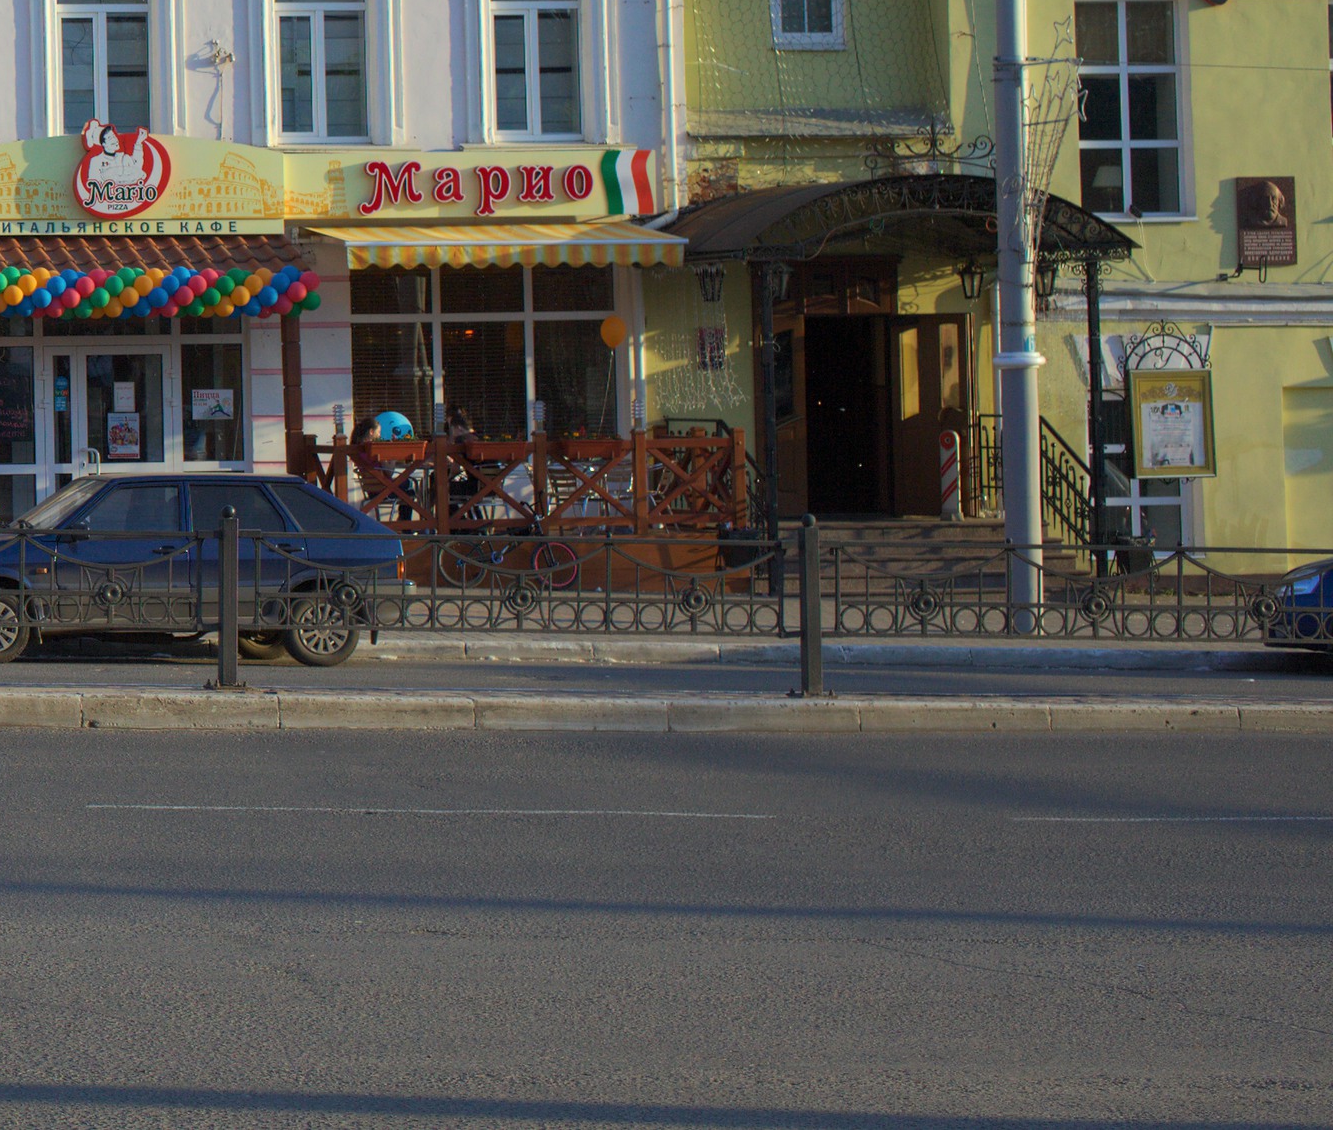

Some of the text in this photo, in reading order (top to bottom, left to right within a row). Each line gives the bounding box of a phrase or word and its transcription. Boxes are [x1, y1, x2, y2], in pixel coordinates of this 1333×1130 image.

[84, 181, 158, 206] Mario
[359, 161, 594, 217] Марио
[107, 203, 129, 211] PIZZA
[1, 221, 238, 234] ИТАЛЬЯНСКОЕ КАФЕ
[193, 390, 220, 400] Пицца
